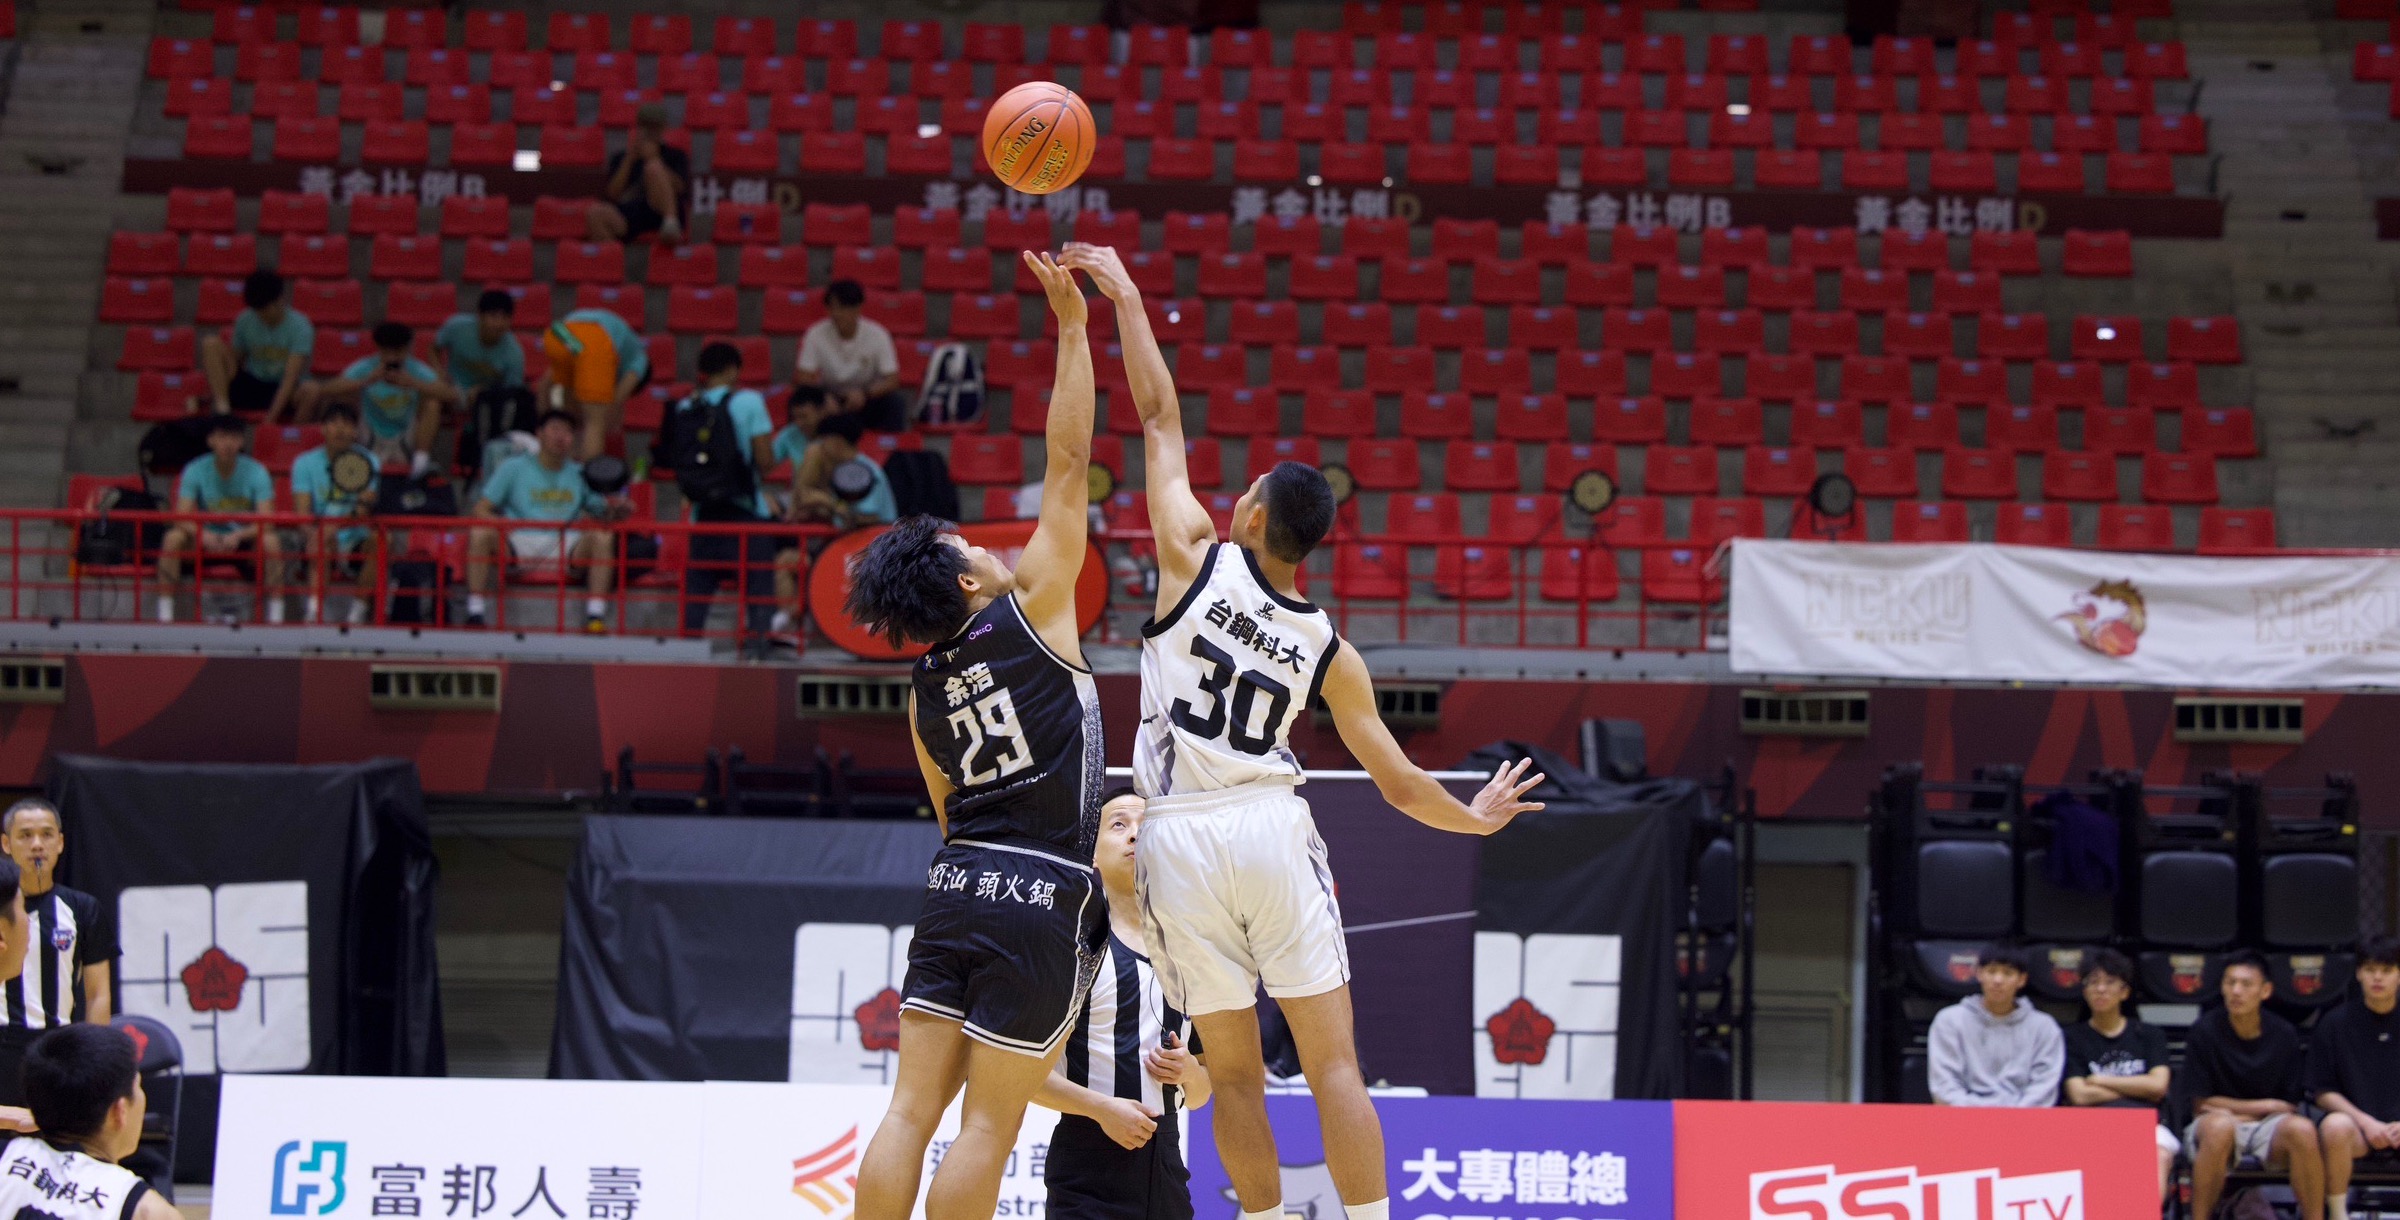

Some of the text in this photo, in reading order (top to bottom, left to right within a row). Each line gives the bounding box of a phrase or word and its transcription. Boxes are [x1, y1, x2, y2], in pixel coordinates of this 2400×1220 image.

[1204, 598, 1306, 674] 台鋼科大
[1253, 610, 1274, 622] OLIVE
[1169, 633, 1292, 755] 30
[947, 686, 1035, 787] 29
[370, 1163, 643, 1220] 富邦人壽
[1401, 1147, 1628, 1206] 大專體總
